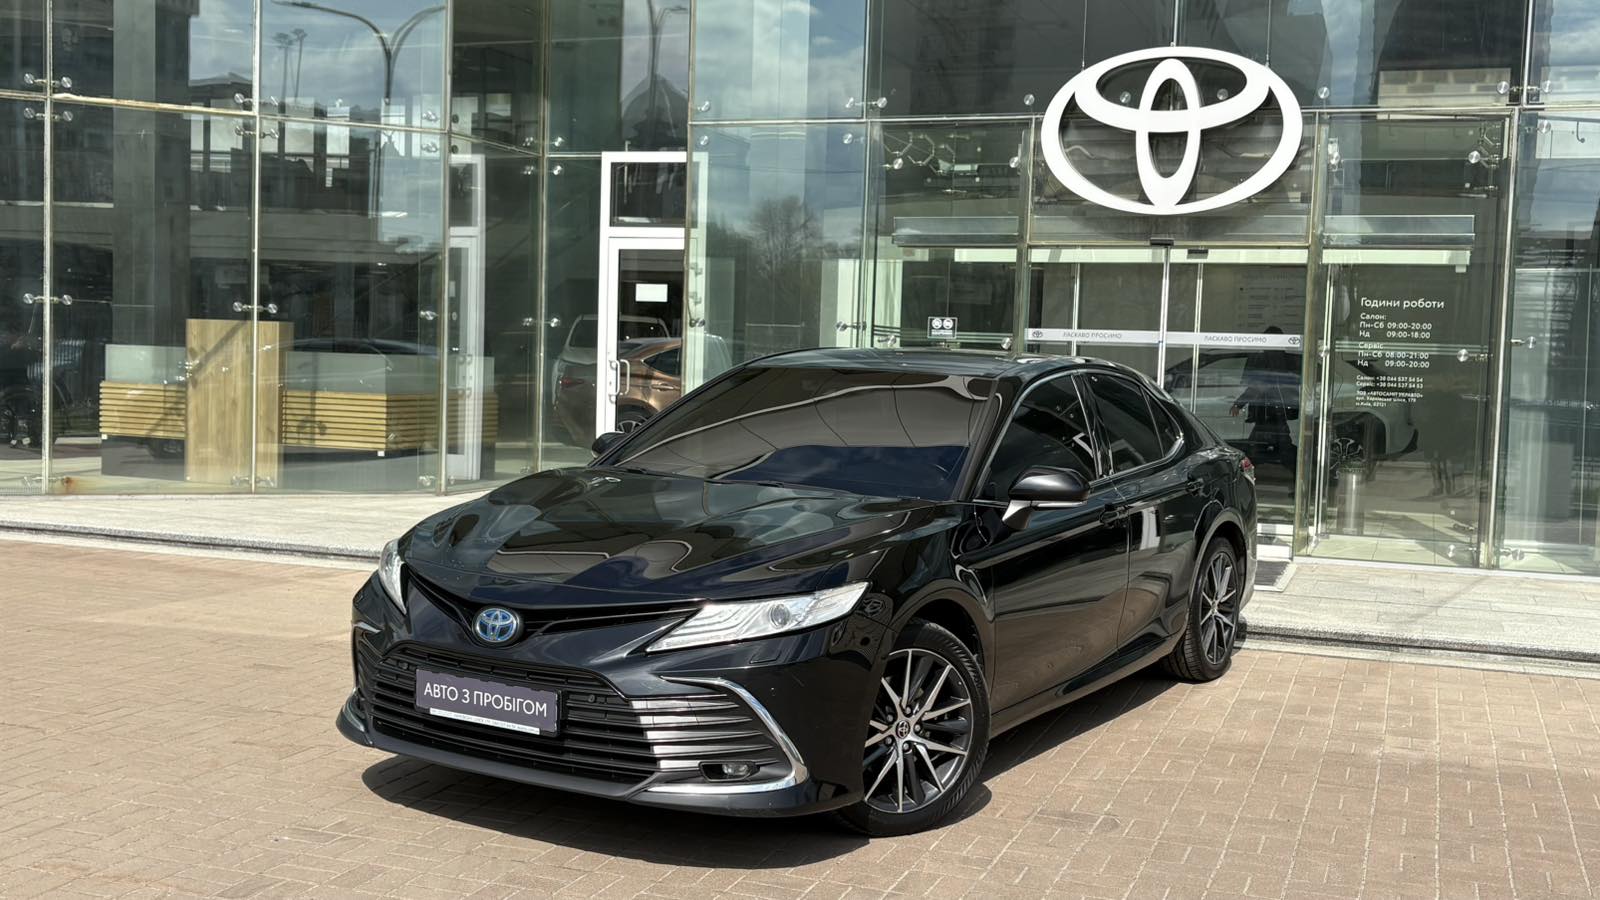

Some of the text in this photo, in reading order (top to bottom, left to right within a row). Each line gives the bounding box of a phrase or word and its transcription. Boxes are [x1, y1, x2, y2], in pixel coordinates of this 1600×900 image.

[1361, 297, 1445, 310] Години роботи
[1360, 312, 1387, 321] Салон:
[1360, 321, 1432, 330] Пн-Сб 09:00-20:00
[1359, 330, 1431, 339] Нд 09:00-18:00
[1358, 350, 1430, 360] Пн-Сб 08:00-21:00
[1357, 360, 1430, 369] Нд 09:00-20:00
[423, 682, 459, 702] АВТО
[473, 690, 547, 718] ПРОБІГОМ
